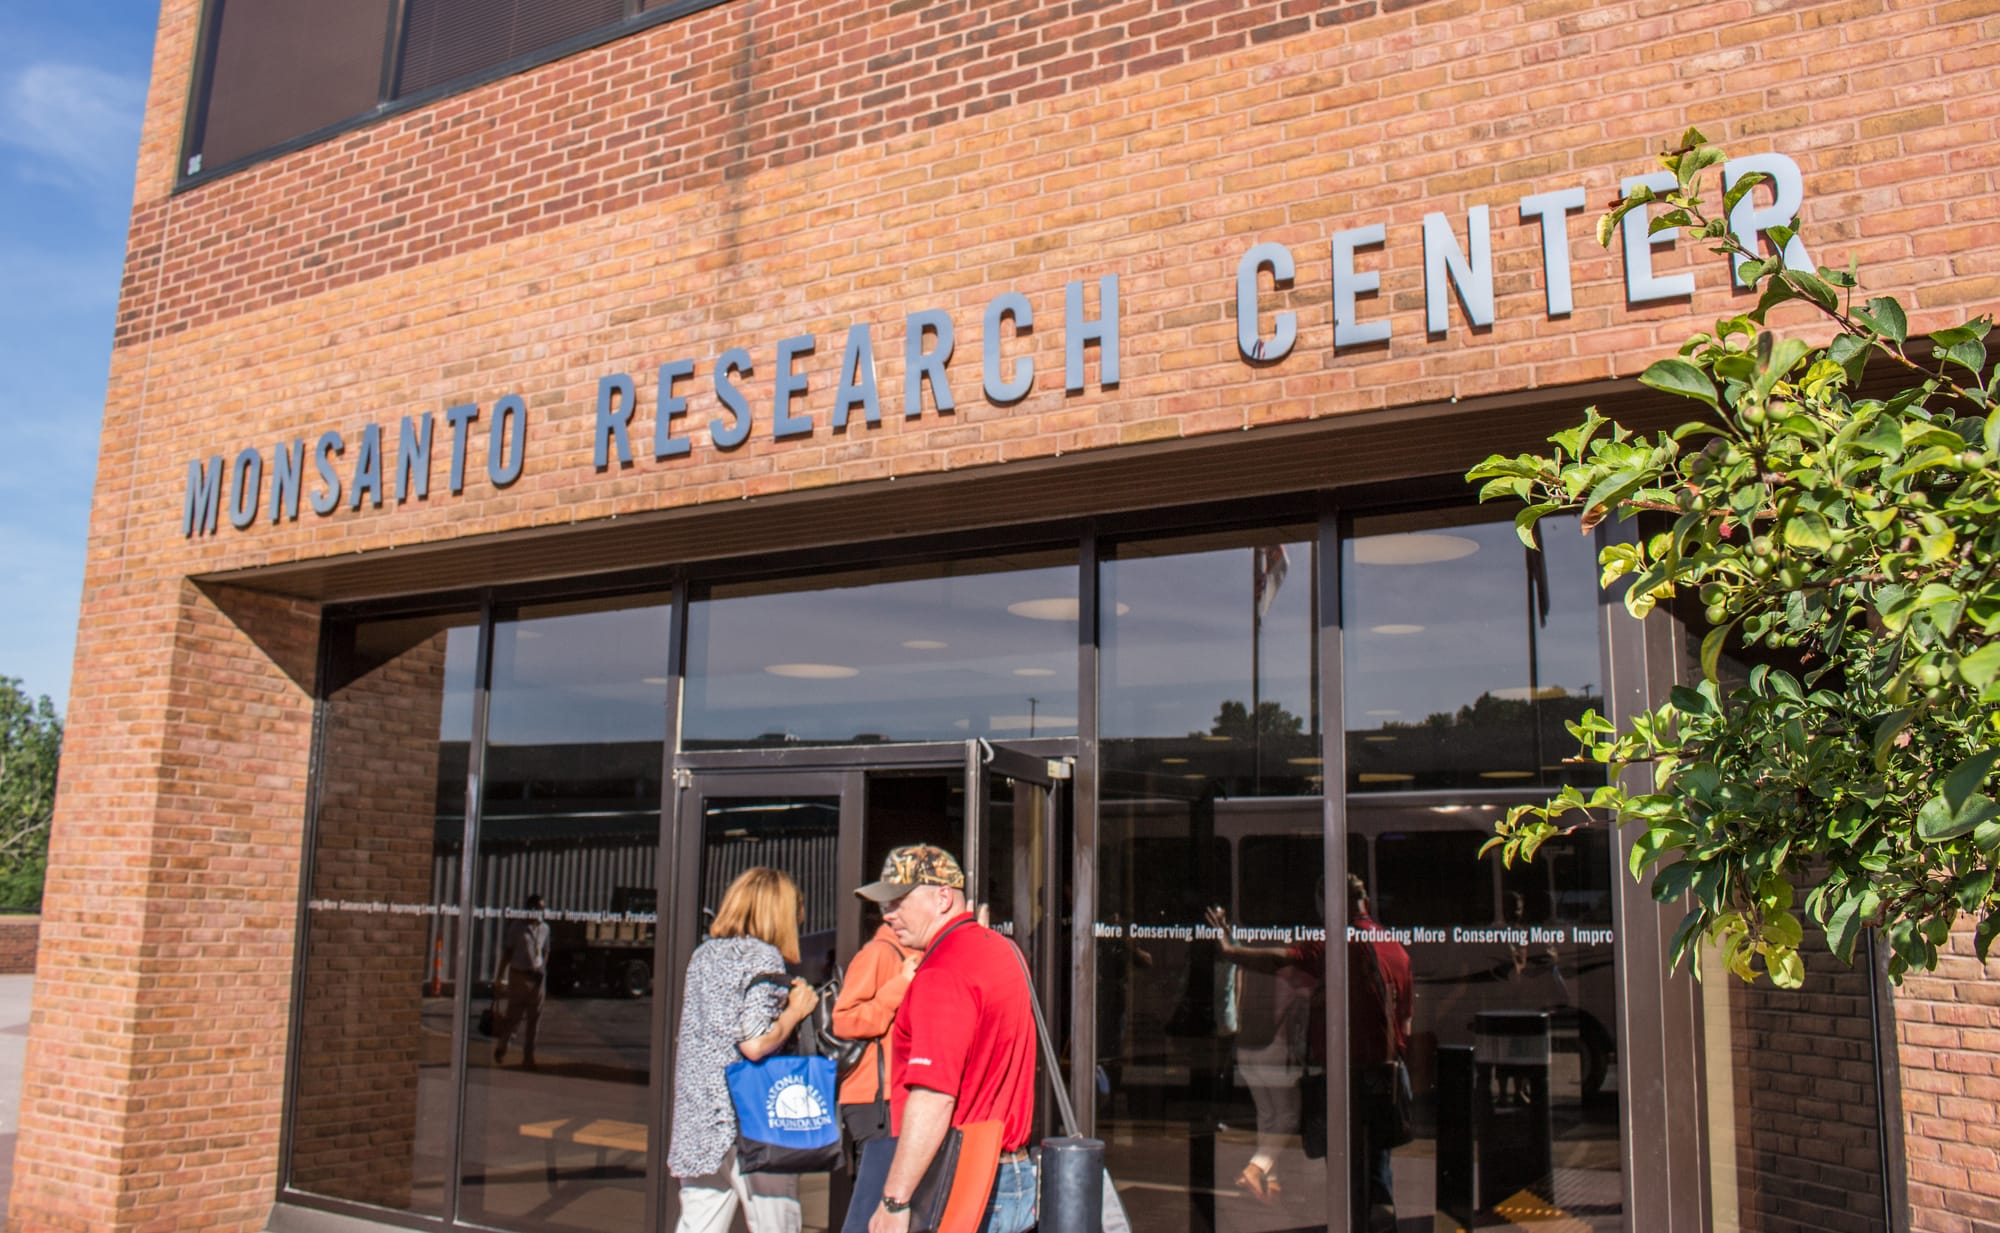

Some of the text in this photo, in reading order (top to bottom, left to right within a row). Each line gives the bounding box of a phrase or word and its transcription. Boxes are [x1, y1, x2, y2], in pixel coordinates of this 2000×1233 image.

[184, 152, 1818, 537] MONSANTO RESEARCH CENTER
[1094, 922, 1326, 944] More Conserving More Improving Lives
[1346, 926, 1412, 945] Producing
[1413, 927, 1446, 943] More
[1452, 927, 1528, 946] Conserving
[1530, 928, 1565, 944] More
